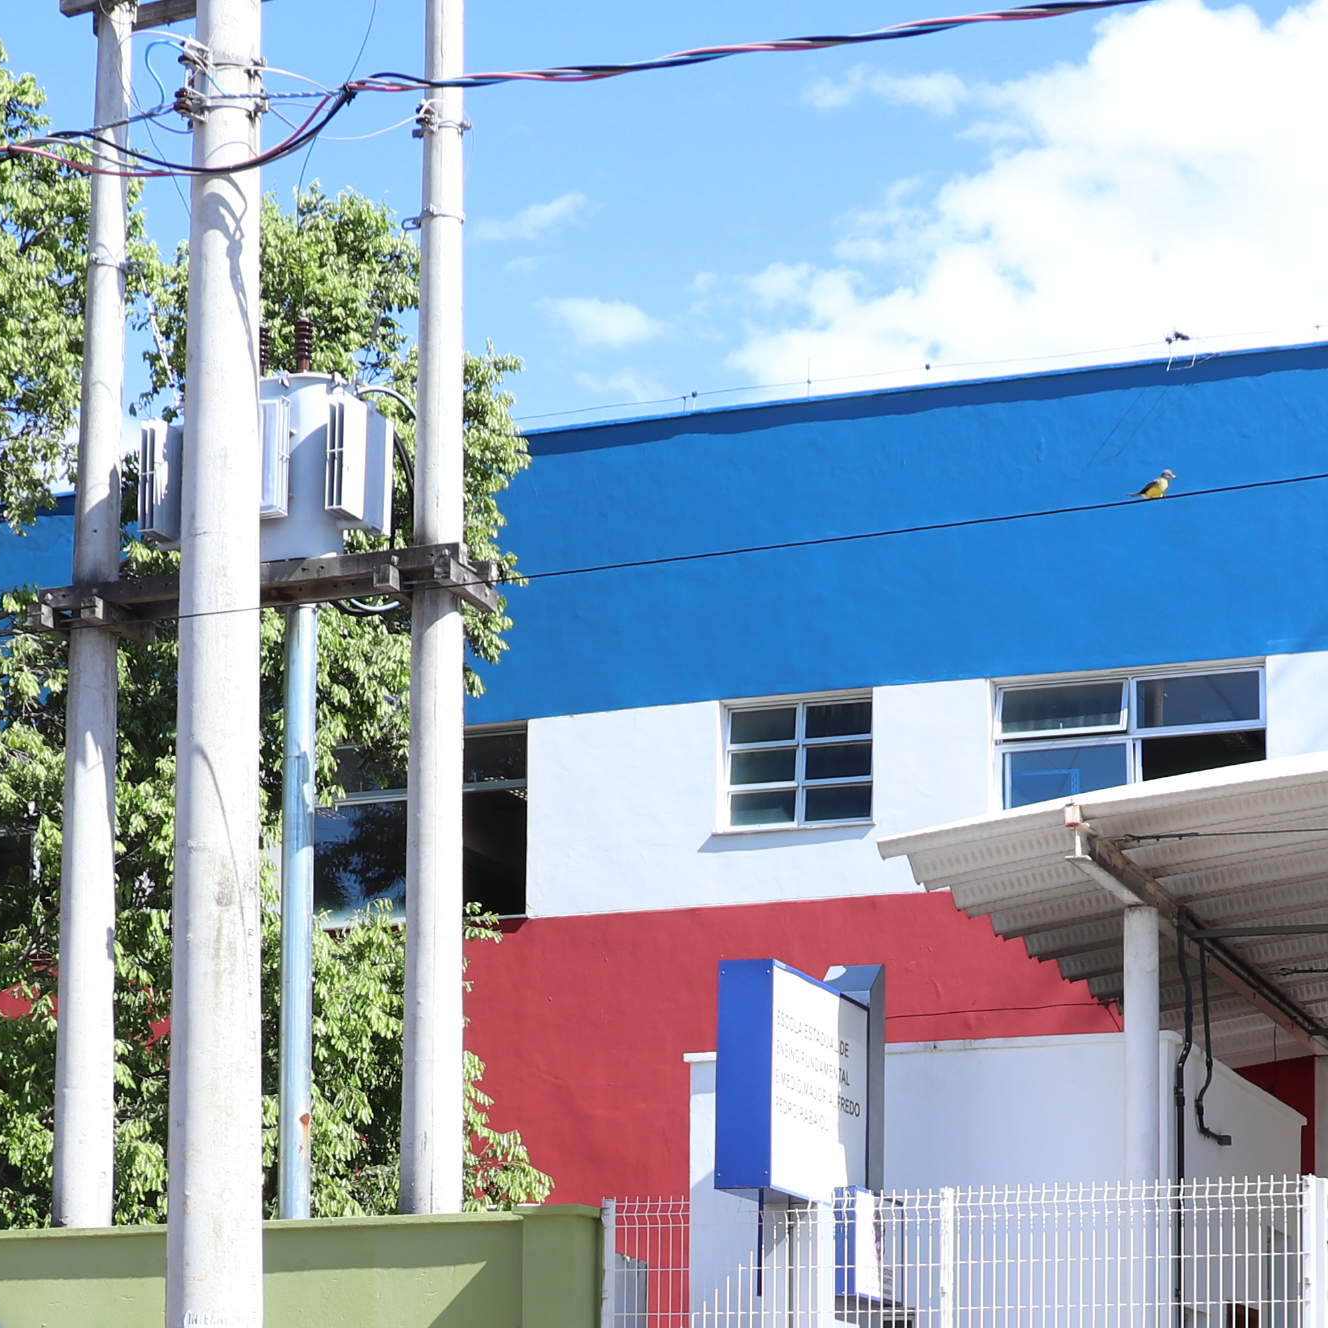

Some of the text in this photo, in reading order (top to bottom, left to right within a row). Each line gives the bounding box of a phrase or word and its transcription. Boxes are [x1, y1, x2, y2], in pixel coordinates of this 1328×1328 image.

[776, 1009, 850, 1059] ESCOLA ESTADUAL DE
[776, 1038, 851, 1087] ENSINO FUNDAMENTAL
[775, 1068, 780, 1084] E
[803, 1081, 827, 1105] MAJOR
[828, 1092, 861, 1118] ALFREDO
[775, 1095, 798, 1119] PEDRO
